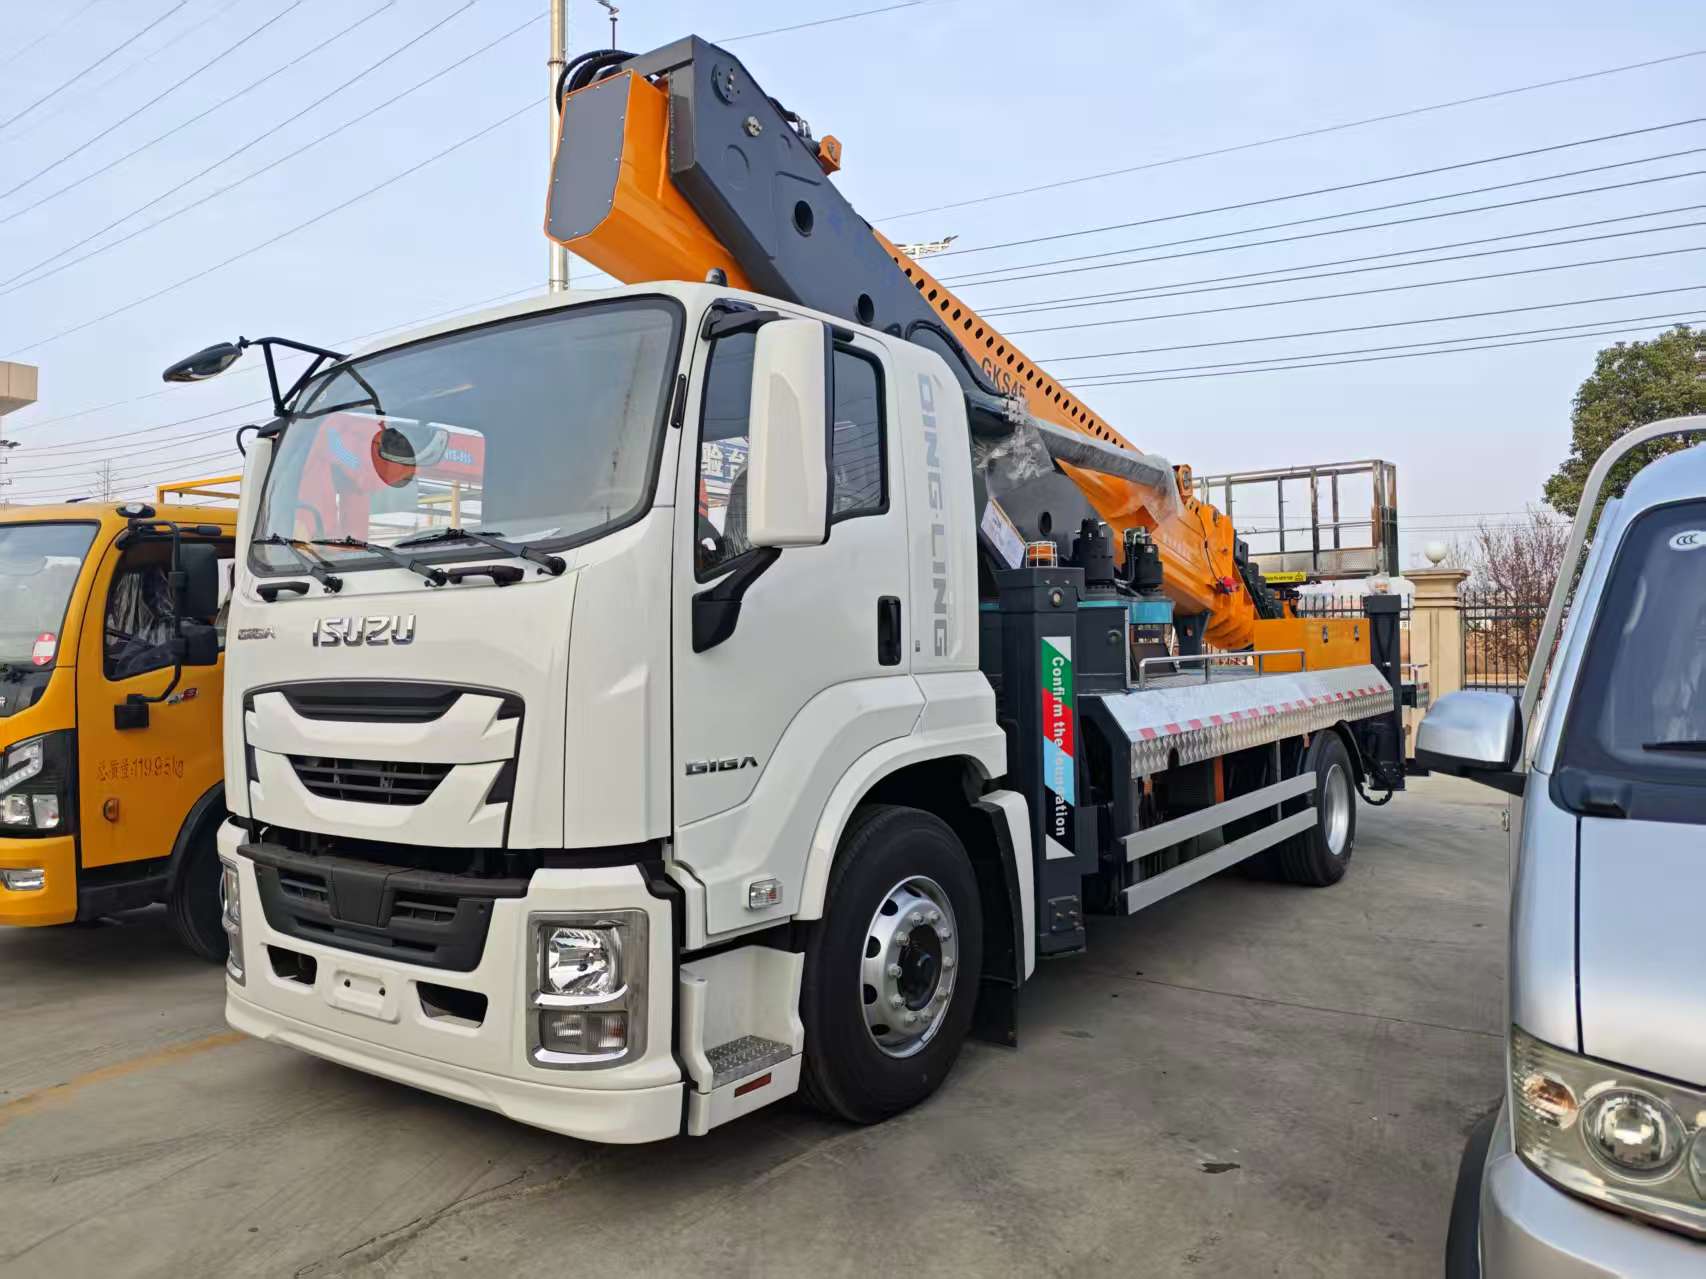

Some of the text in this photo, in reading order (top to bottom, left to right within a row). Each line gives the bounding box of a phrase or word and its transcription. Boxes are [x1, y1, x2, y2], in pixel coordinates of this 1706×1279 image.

[312, 614, 416, 647] ISUZU
[1052, 656, 1065, 717] Confirm
[1054, 718, 1066, 747] the
[685, 756, 758, 776] GIGA
